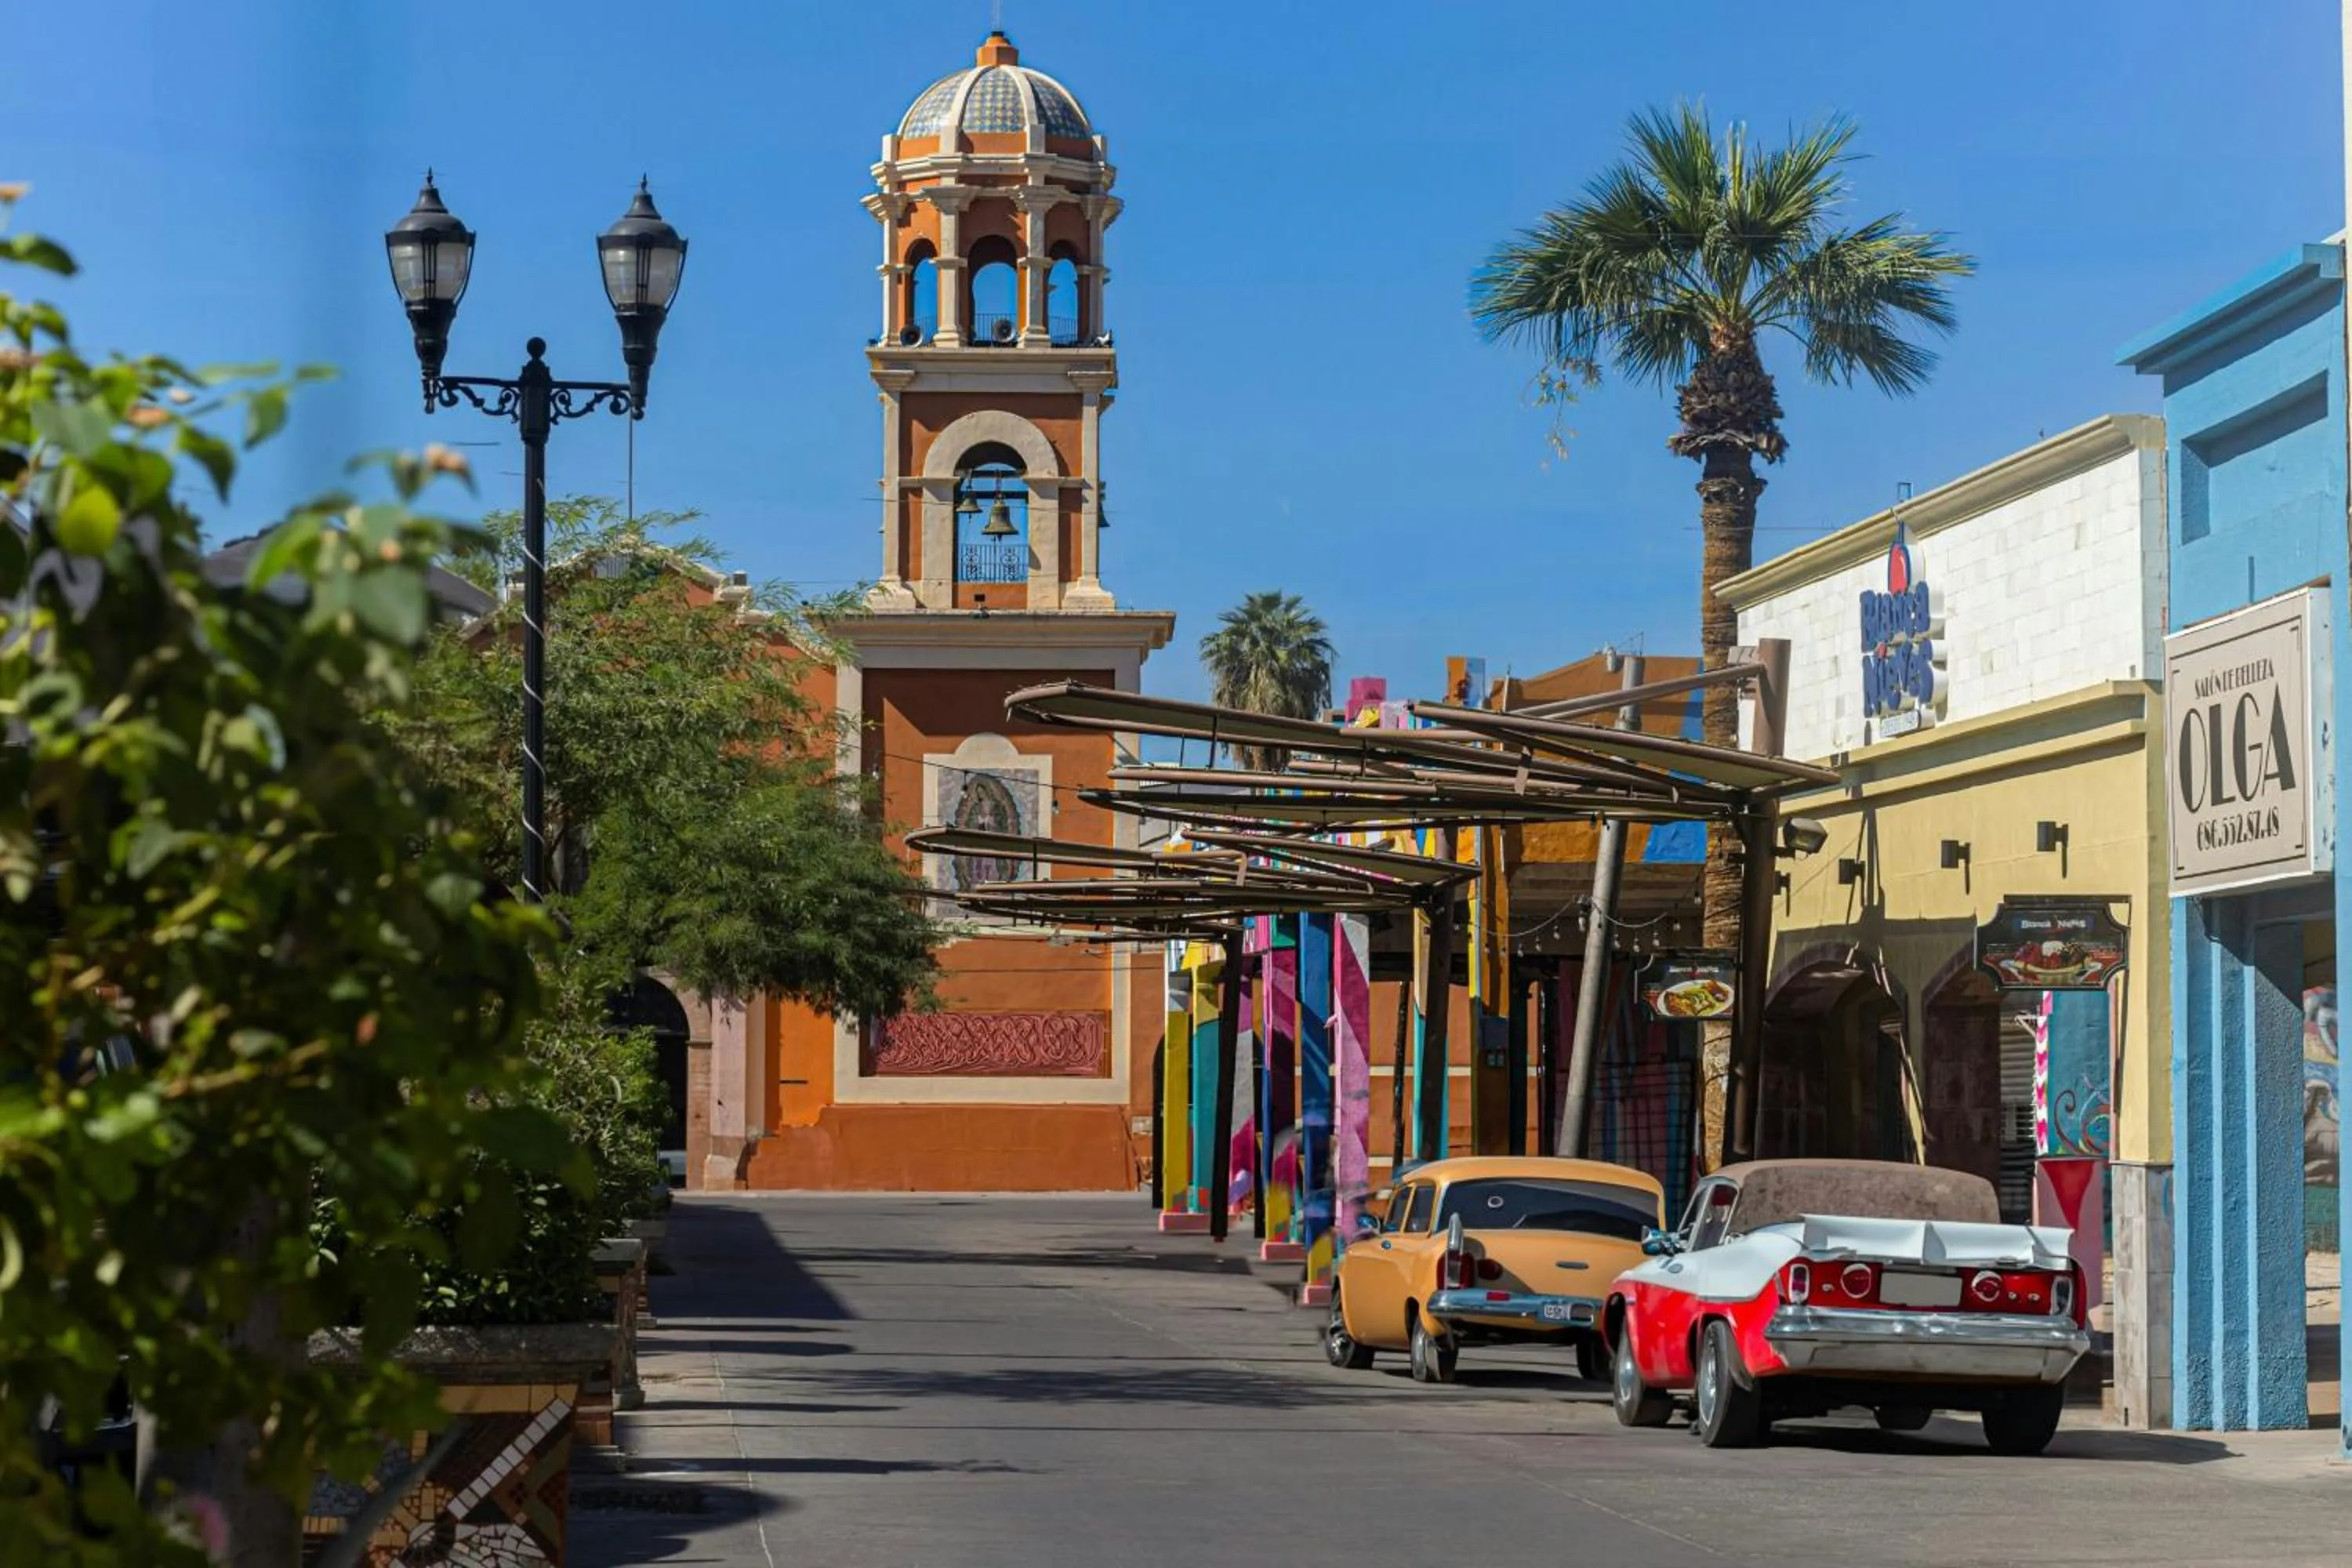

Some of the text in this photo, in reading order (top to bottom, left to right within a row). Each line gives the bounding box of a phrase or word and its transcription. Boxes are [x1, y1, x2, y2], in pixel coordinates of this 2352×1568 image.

[2223, 669, 2234, 691] DE
[2235, 658, 2274, 688] BELLEZA
[2178, 681, 2296, 814] OLGA
